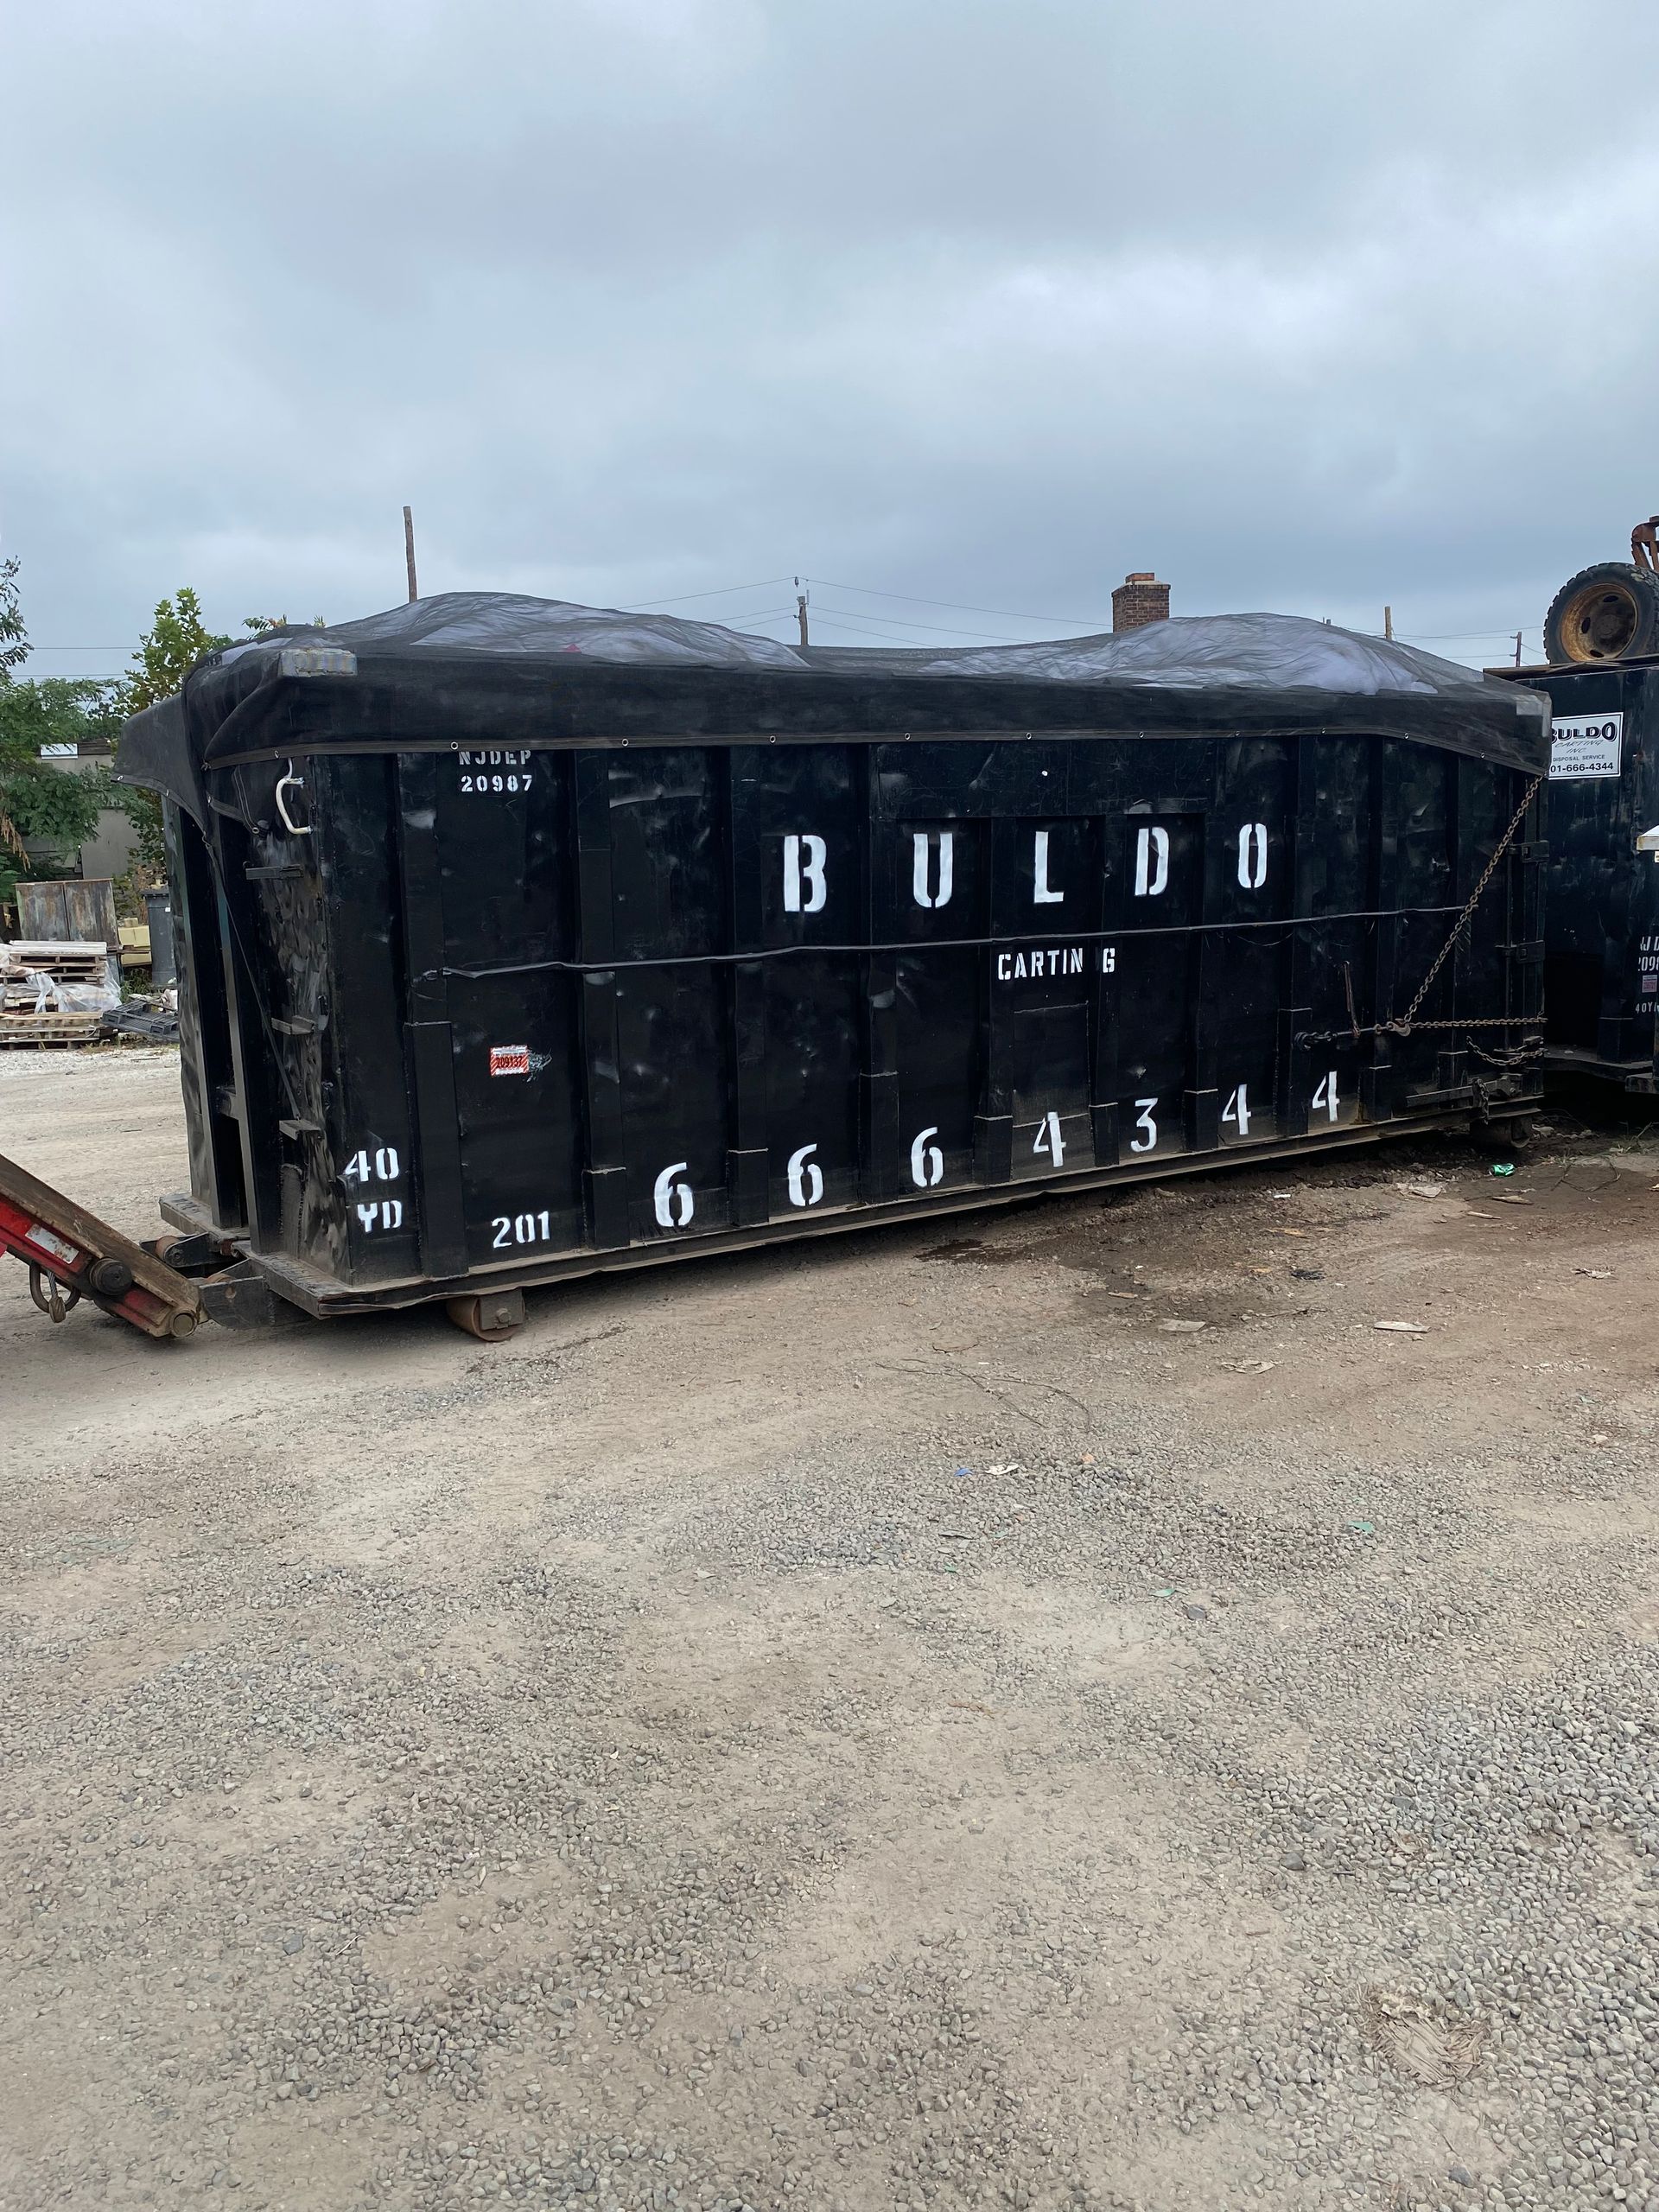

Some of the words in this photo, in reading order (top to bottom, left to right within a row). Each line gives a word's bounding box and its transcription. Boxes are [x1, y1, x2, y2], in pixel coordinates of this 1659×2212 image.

[1555, 740, 1604, 748] CARTING
[459, 750, 531, 766] NJDEP
[461, 774, 532, 792] 20987
[345, 1147, 400, 1182] 40
[357, 1200, 403, 1233] YD
[492, 1211, 550, 1249] 201
